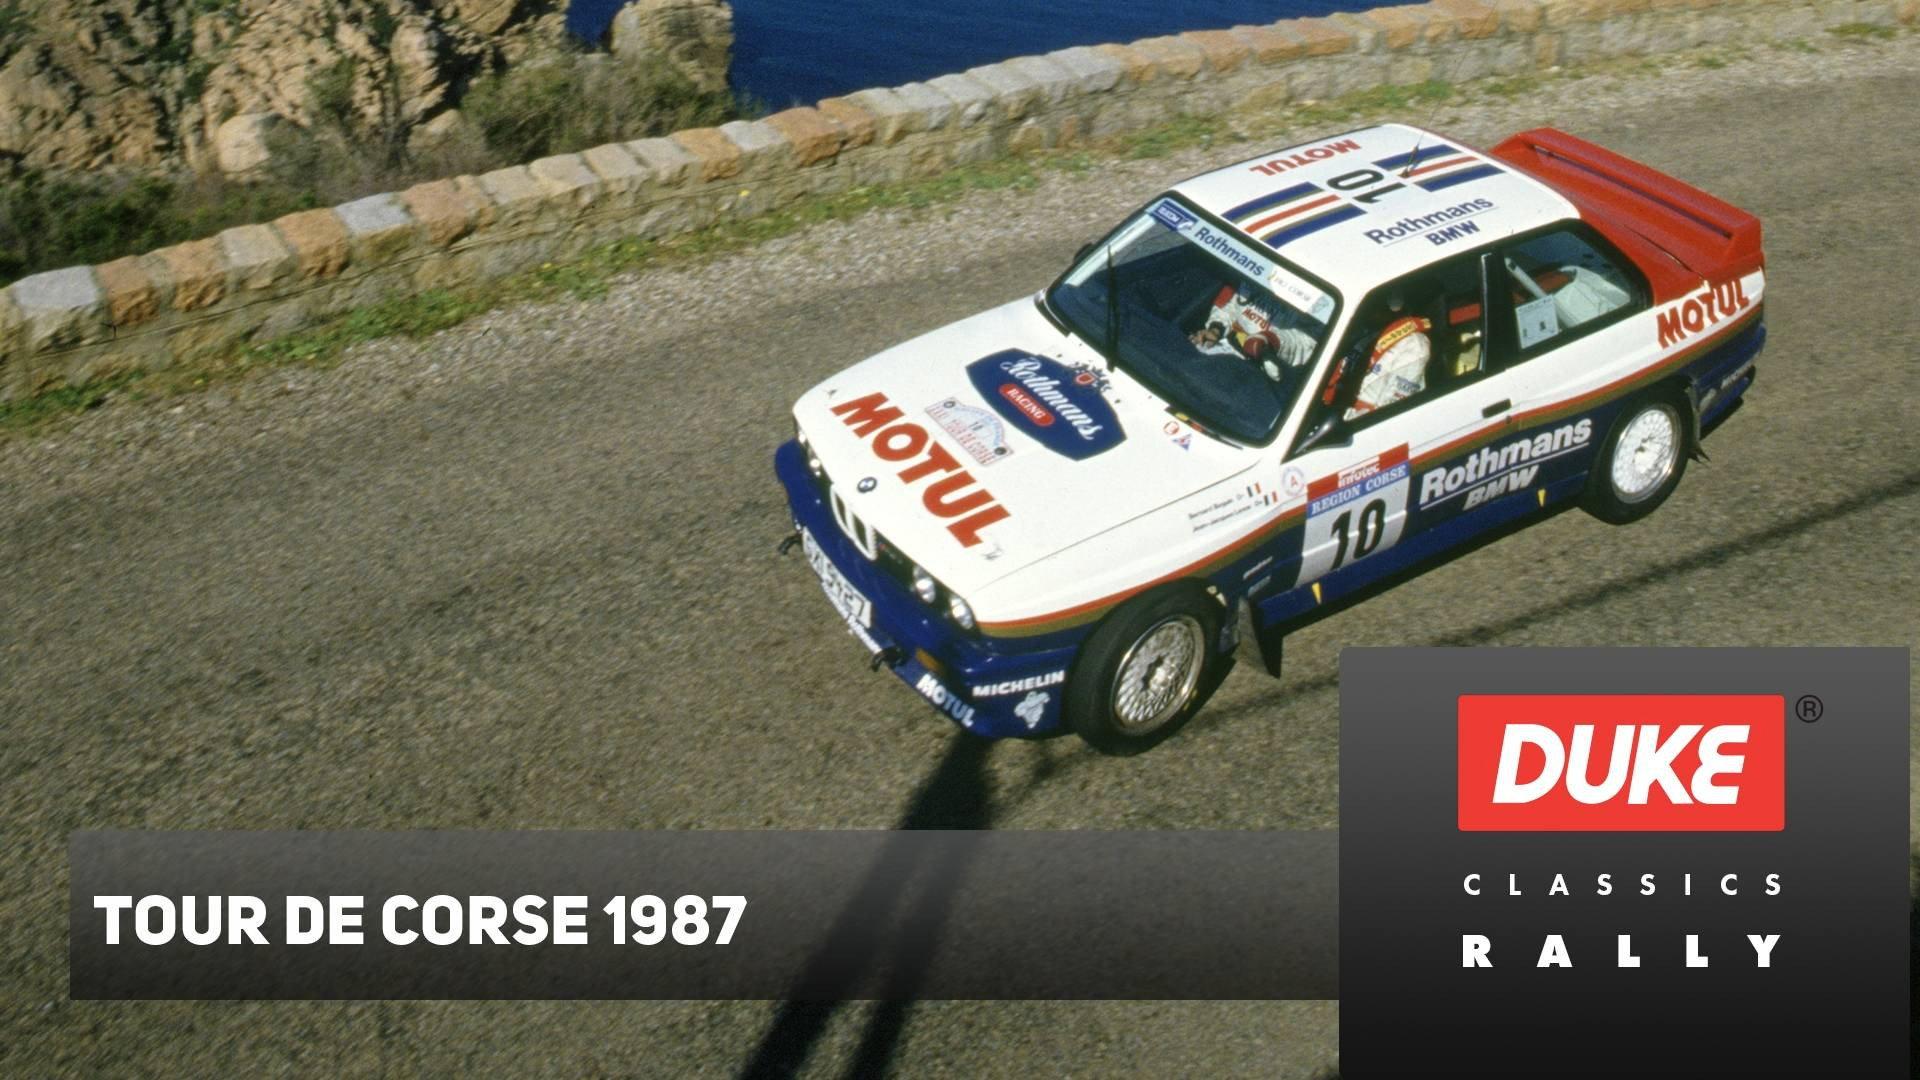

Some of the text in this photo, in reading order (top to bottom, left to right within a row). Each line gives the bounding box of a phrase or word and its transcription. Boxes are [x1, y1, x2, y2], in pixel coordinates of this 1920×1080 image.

[1249, 139, 1362, 176] MOTUL
[1327, 169, 1406, 204] 10
[1363, 198, 1494, 245] Rothmans
[1425, 220, 1480, 246] BMW
[1194, 227, 1265, 277] Rothmans
[1656, 278, 1750, 349] MOTUL
[1000, 358, 1104, 440] Rothmans
[1006, 385, 1047, 420] RACING
[830, 392, 1011, 548] MOTUL
[1419, 418, 1592, 505] Rothmans
[1312, 464, 1407, 514] REGION CORSE
[1463, 464, 1539, 511] BMW
[1330, 498, 1386, 571] 10
[915, 673, 975, 728] MOTUL
[972, 670, 1064, 697] MICHELIN
